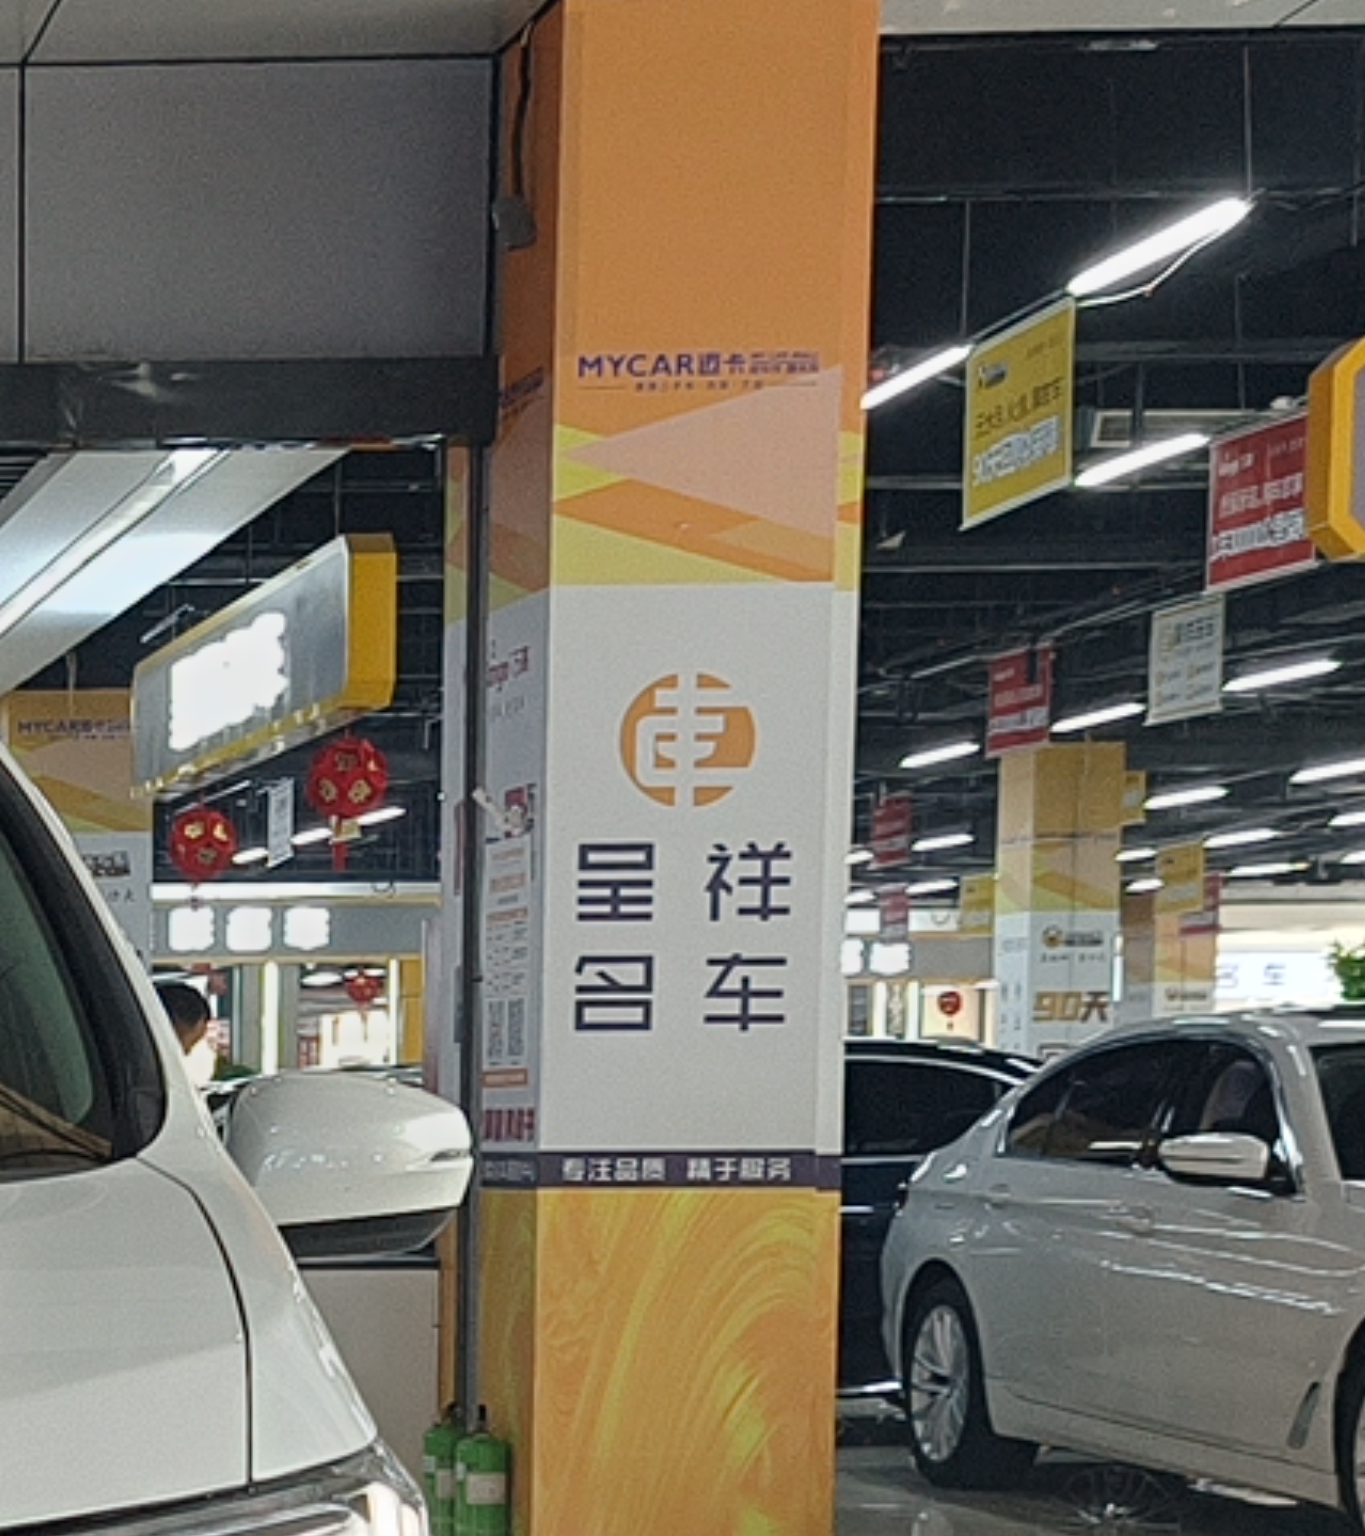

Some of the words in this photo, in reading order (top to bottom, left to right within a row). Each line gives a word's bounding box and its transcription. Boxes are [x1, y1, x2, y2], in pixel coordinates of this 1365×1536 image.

[576, 841, 793, 923] 呈祥
[573, 952, 788, 1033] 名车
[1033, 991, 1110, 1022] 90天
